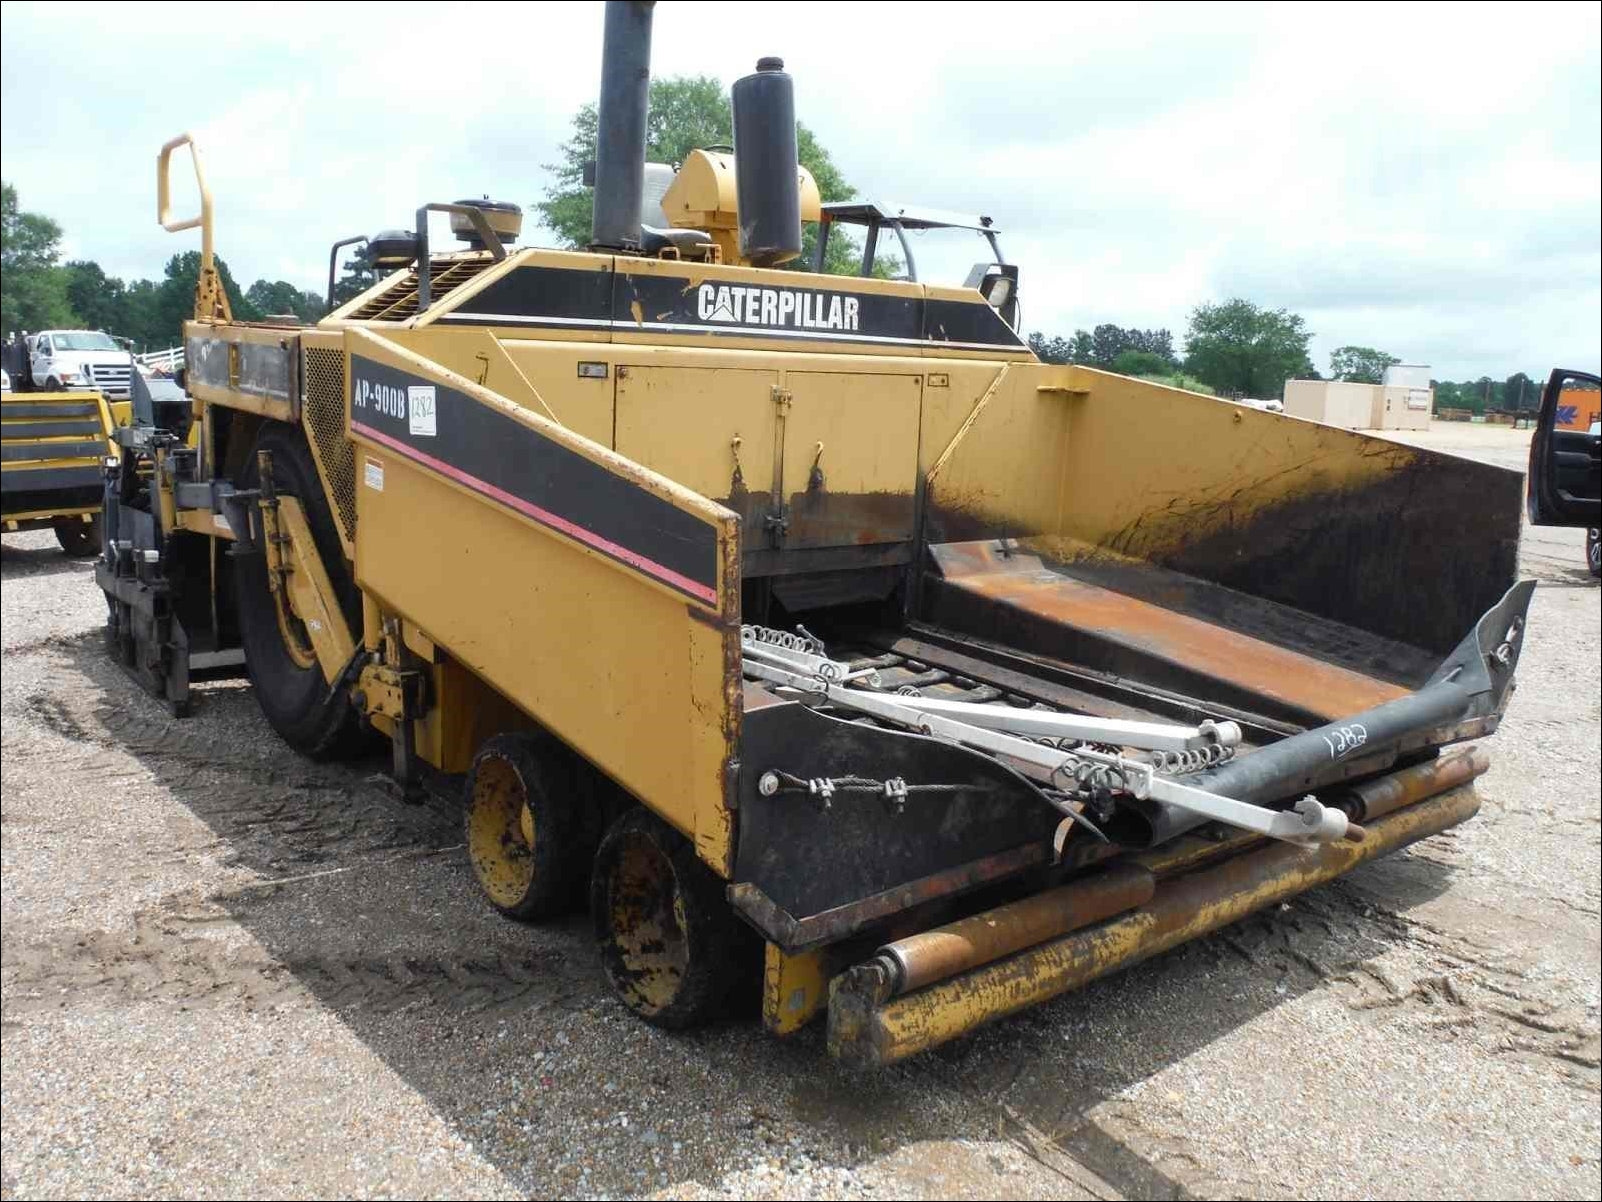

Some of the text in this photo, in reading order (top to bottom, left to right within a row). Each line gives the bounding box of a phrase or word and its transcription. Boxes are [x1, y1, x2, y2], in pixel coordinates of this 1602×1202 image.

[698, 284, 860, 330] CATERPILLAR
[354, 378, 405, 419] AP-900B
[411, 395, 434, 419] 1282
[1323, 723, 1368, 760] 1282
